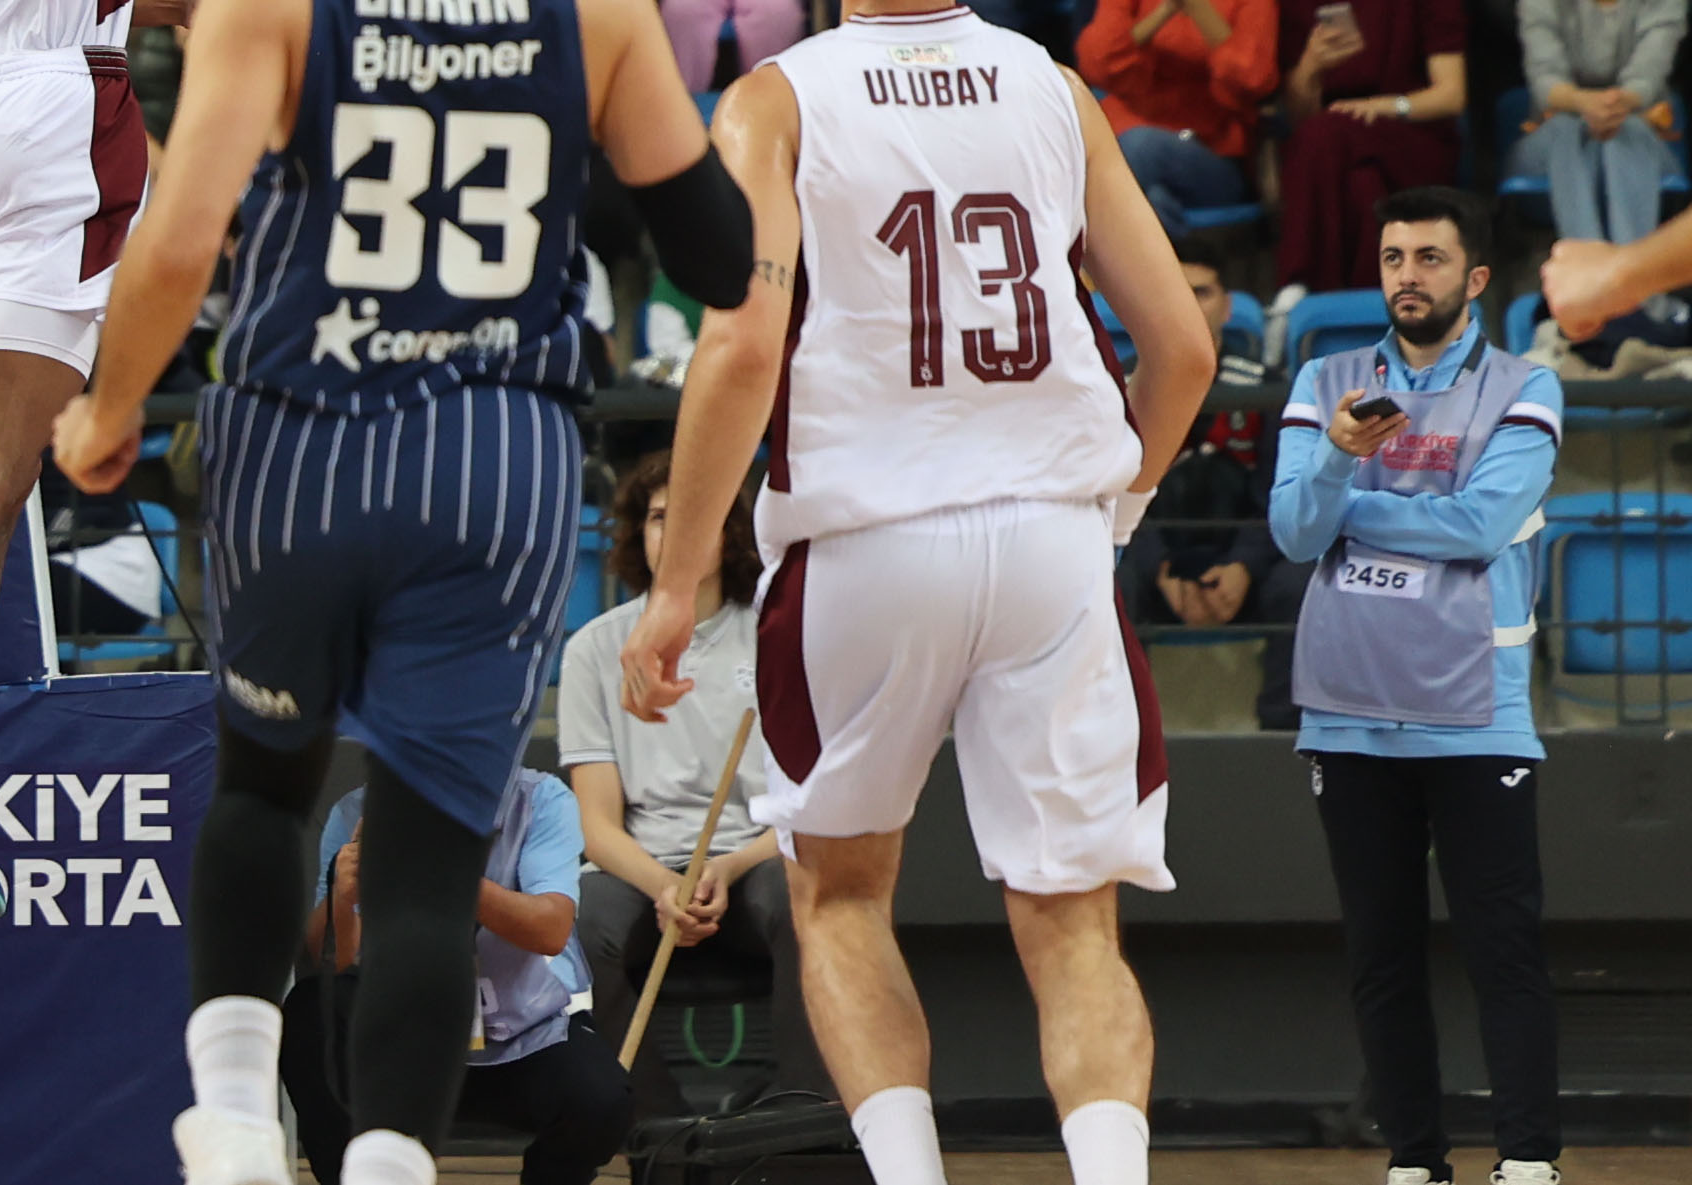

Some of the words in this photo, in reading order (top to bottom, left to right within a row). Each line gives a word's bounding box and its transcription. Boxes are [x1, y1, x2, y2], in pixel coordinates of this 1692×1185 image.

[352, 24, 542, 93] Bilyoner
[863, 66, 999, 107] ULUBAY
[324, 102, 552, 300] 33
[875, 190, 1052, 389] 13
[1345, 563, 1409, 590] 2456
